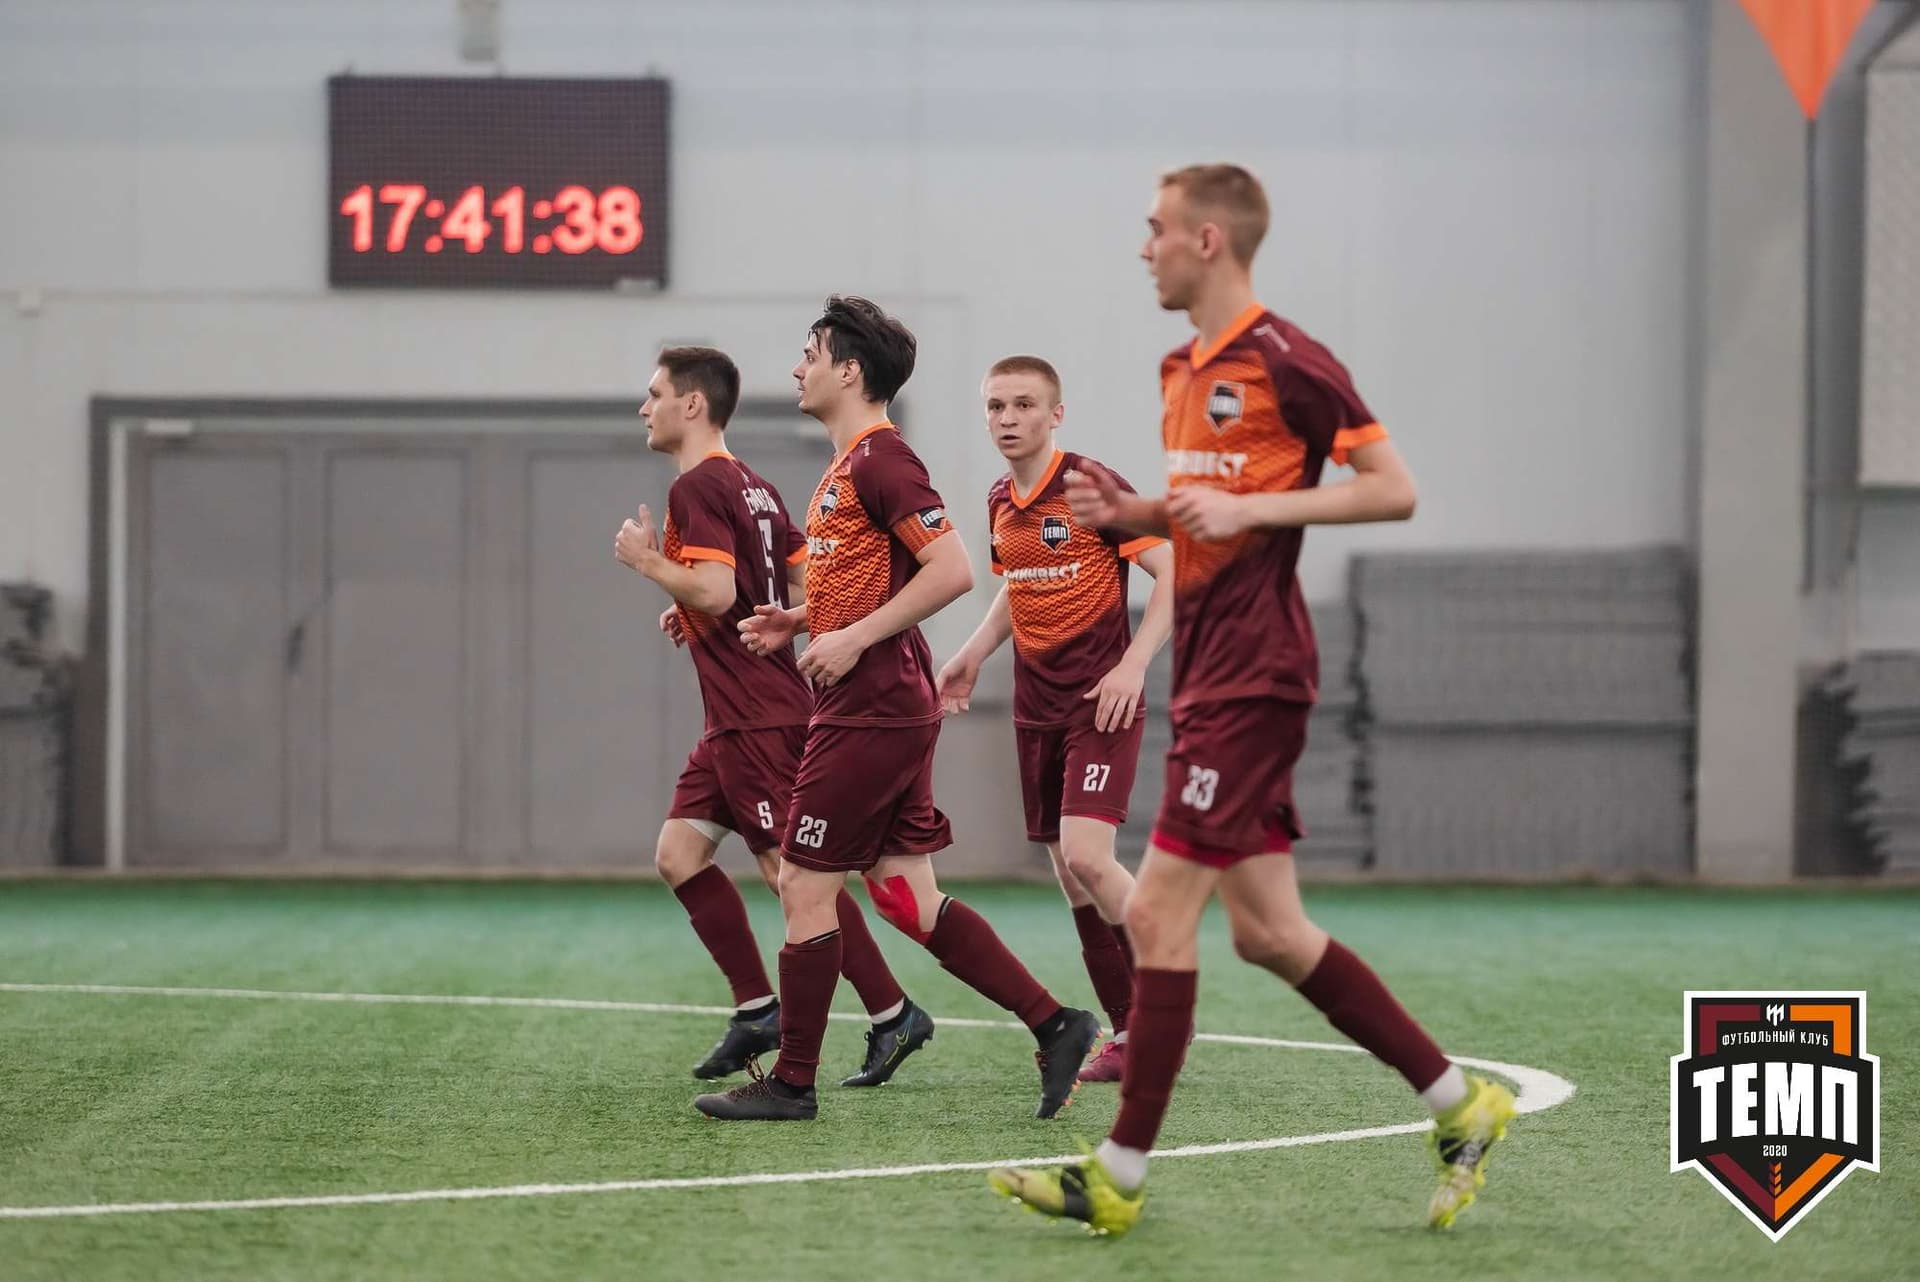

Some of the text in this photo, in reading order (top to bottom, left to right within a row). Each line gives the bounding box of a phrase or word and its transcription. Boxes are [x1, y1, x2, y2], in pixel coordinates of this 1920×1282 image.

[340, 184, 644, 254] 17:41:38
[1044, 526, 1067, 540] ТЕМП
[1083, 763, 1111, 791] 27
[757, 800, 774, 829] 5
[795, 815, 828, 848] 23
